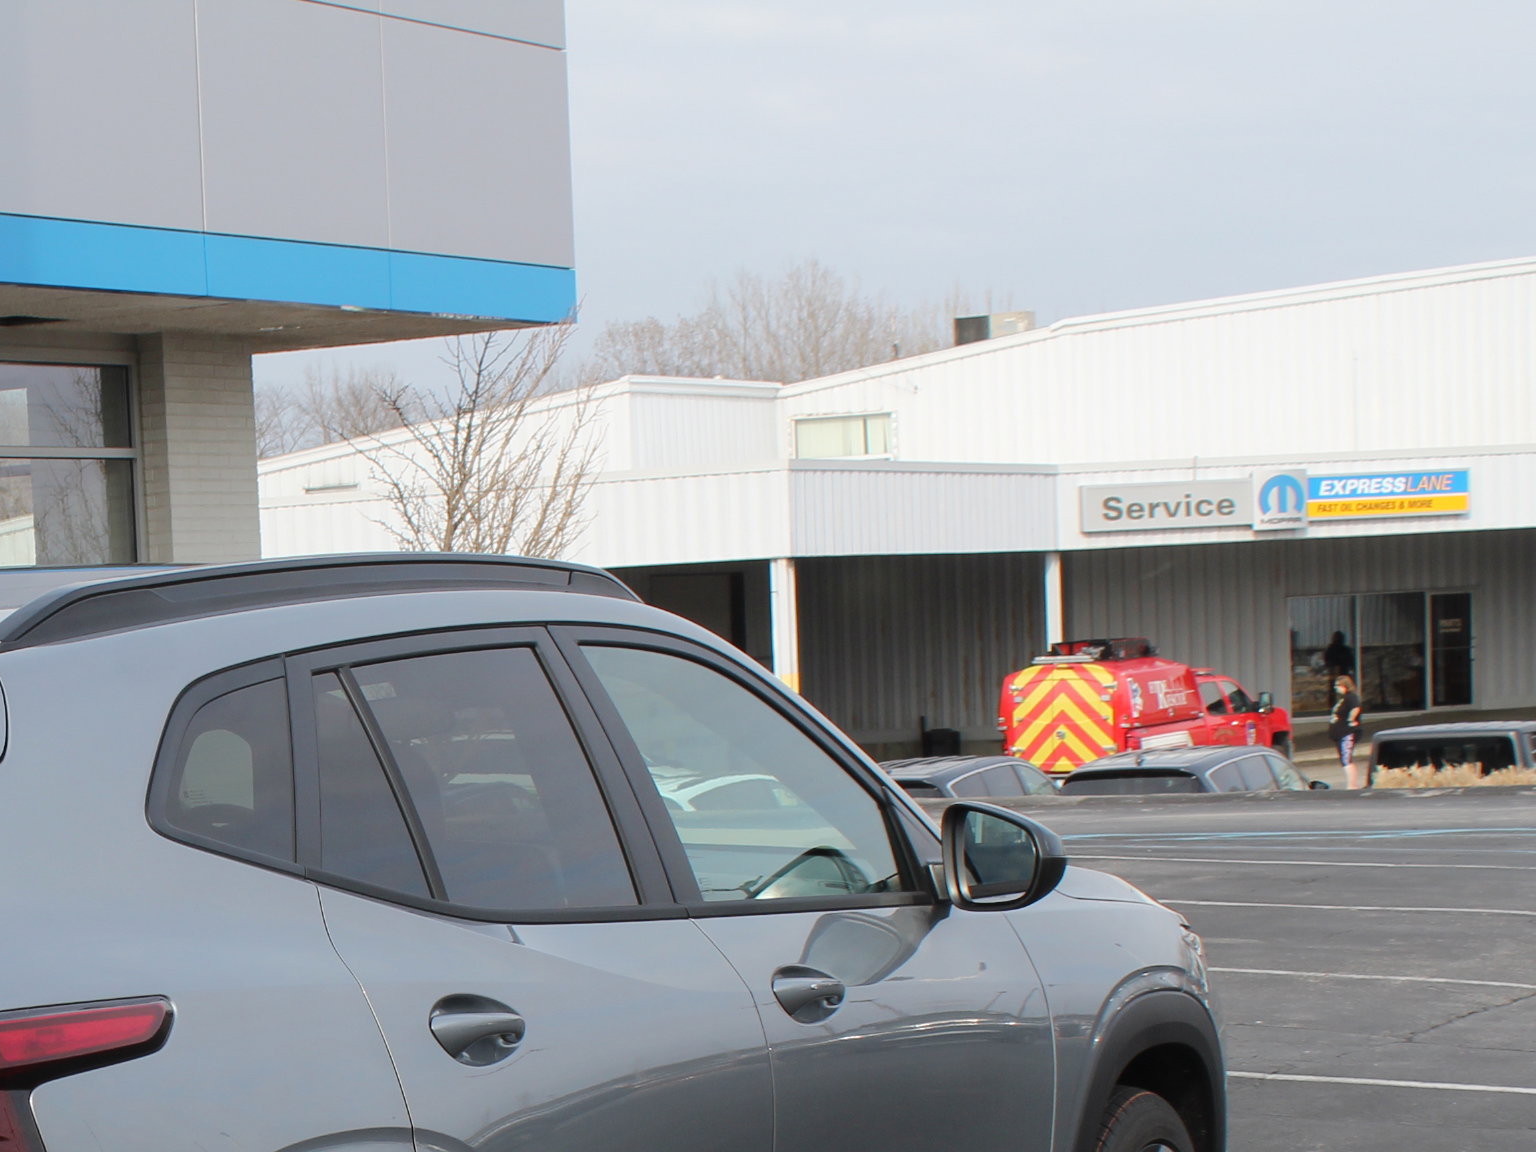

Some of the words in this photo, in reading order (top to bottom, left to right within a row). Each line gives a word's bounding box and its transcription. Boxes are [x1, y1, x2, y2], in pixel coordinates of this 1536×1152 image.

[1102, 493, 1236, 521] Service
[1317, 503, 1338, 513] FAST
[1340, 502, 1353, 512] OIL
[1356, 501, 1396, 511] CHANGES
[1408, 499, 1433, 509] MORE
